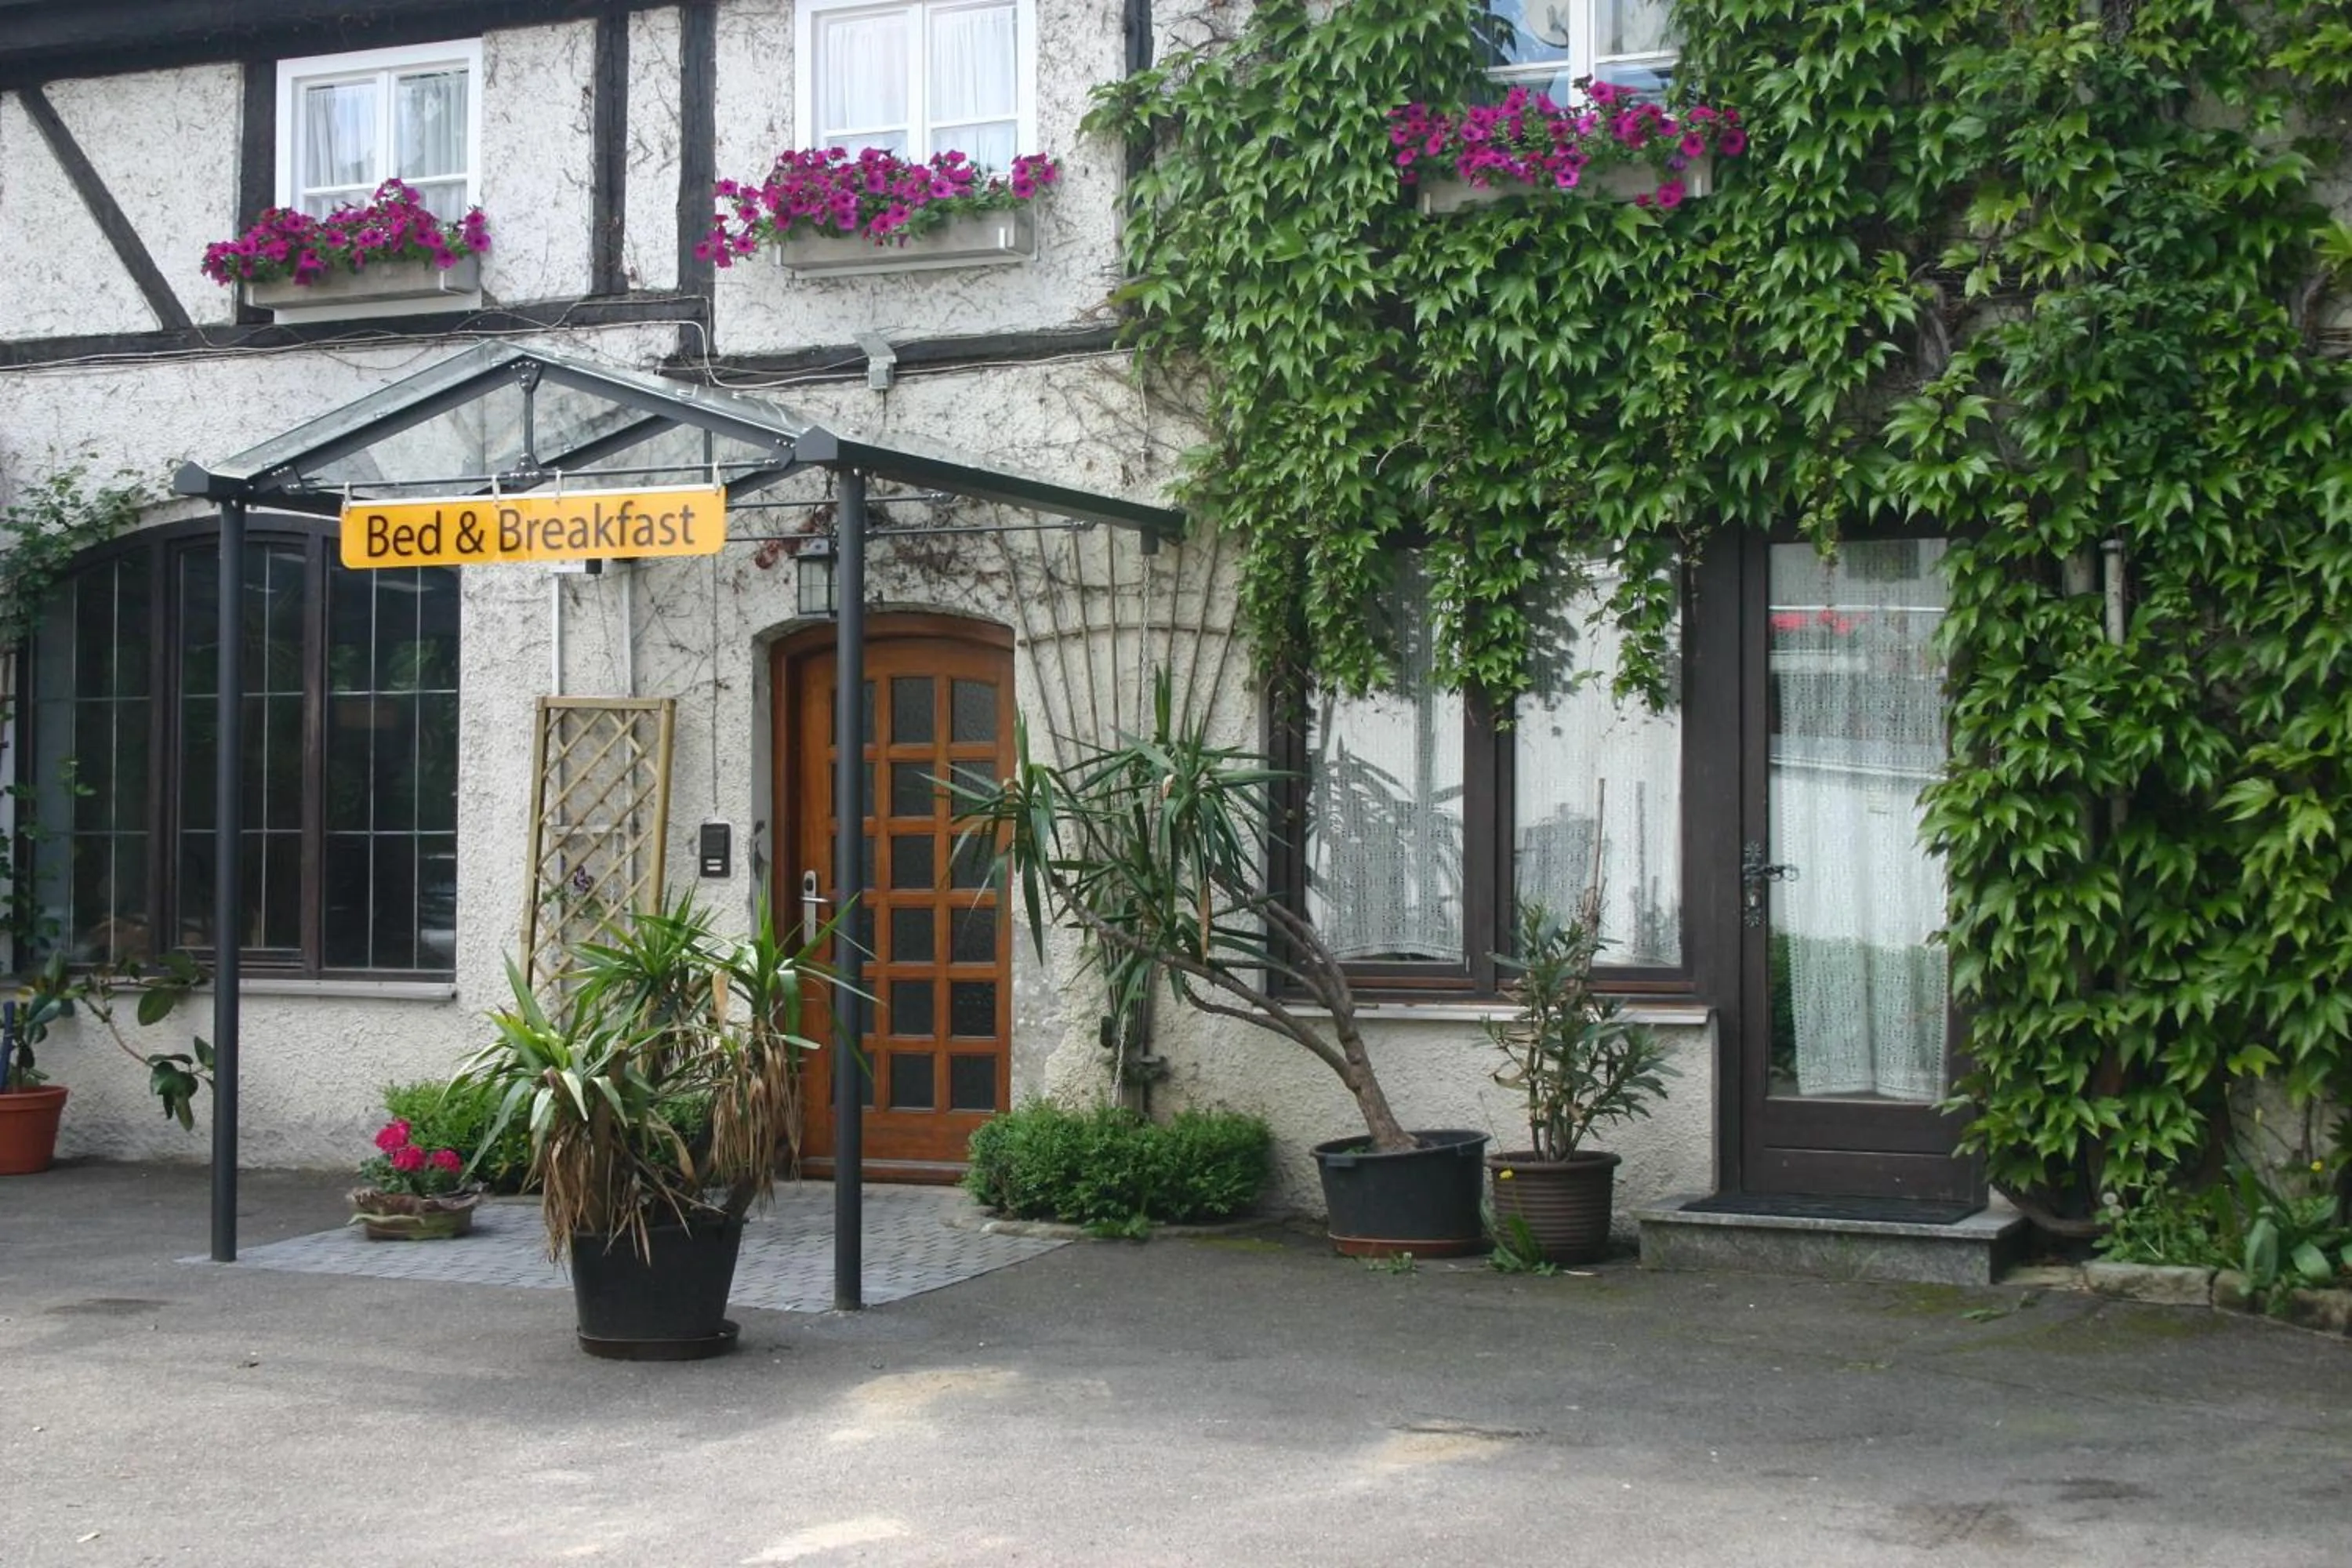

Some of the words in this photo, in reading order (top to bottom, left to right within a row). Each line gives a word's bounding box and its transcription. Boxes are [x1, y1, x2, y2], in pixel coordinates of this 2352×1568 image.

[366, 510, 441, 557] Bed
[455, 510, 485, 554] &
[499, 500, 695, 553] Breakfast
